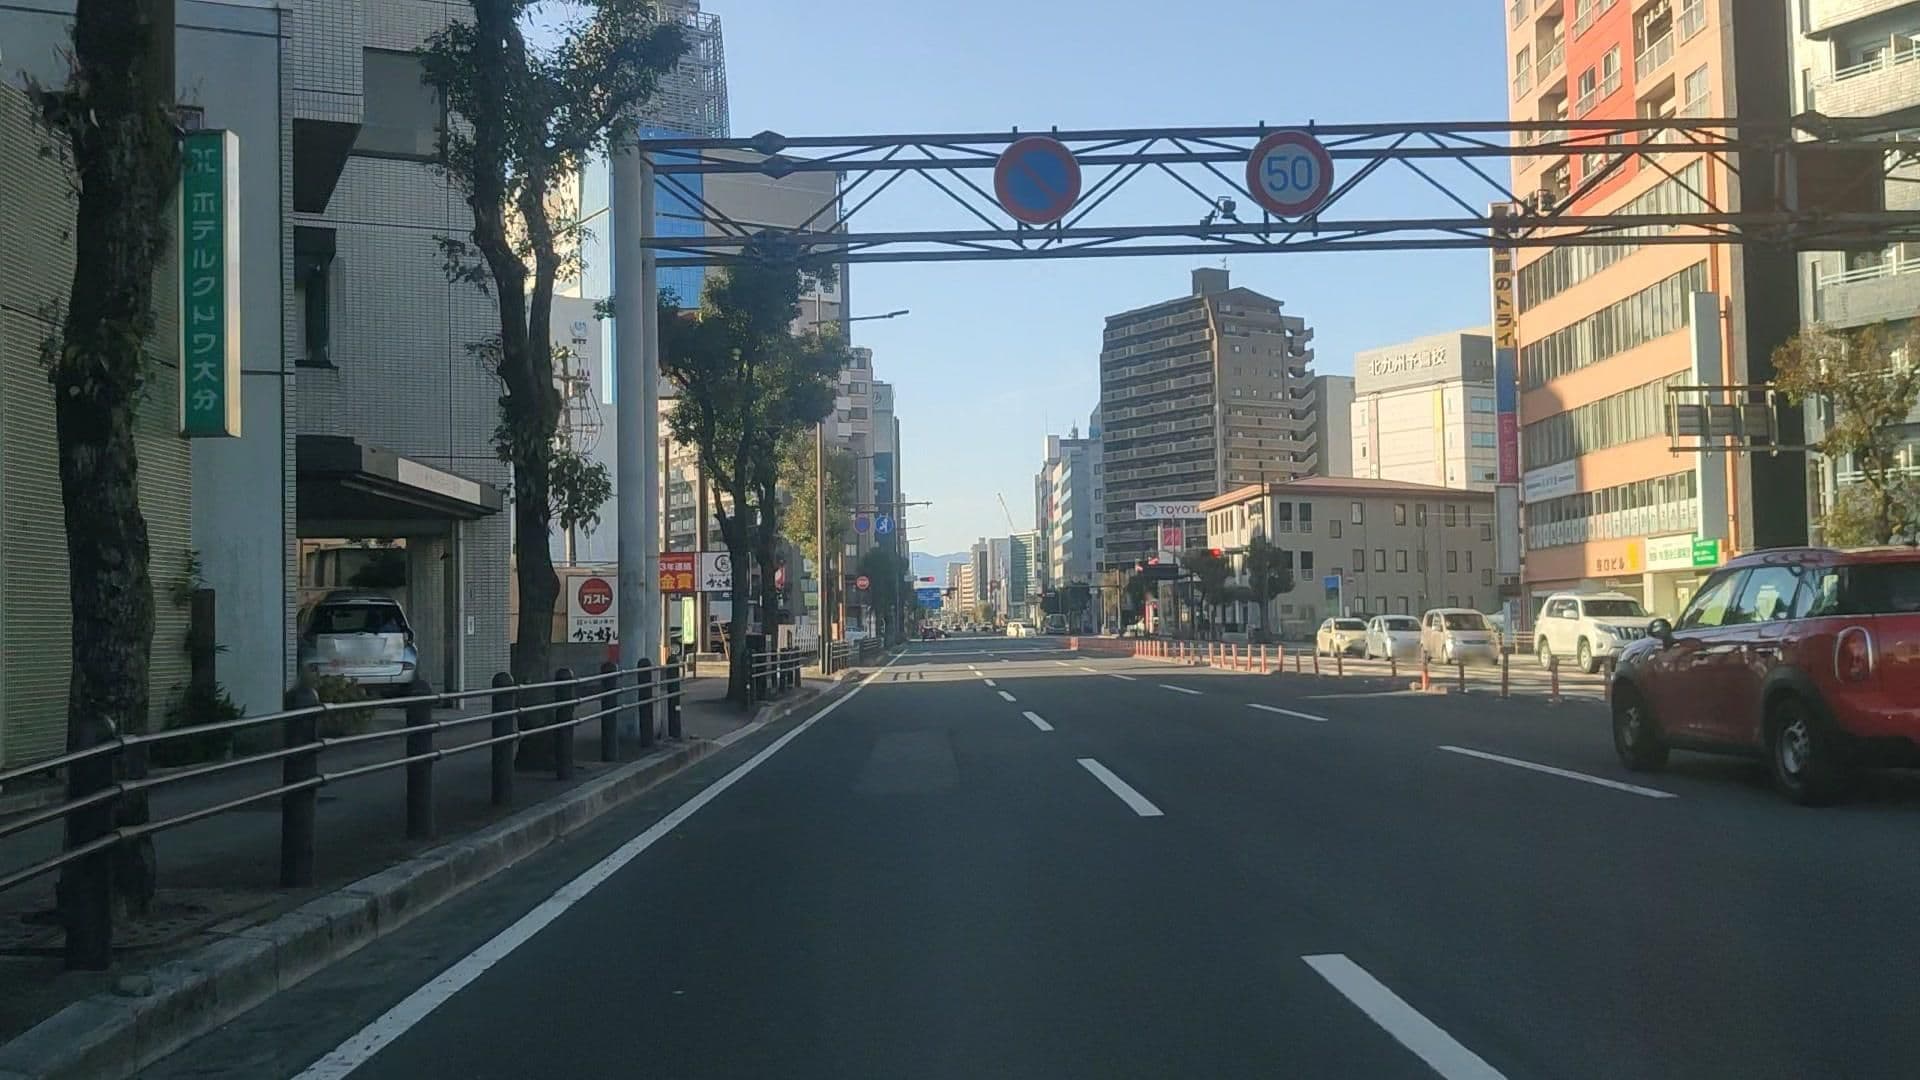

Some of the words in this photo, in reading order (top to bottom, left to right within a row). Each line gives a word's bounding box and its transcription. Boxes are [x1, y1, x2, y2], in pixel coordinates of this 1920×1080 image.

[1267, 156, 1313, 191] 50
[191, 191, 219, 411] ホテルクドウ大分
[1159, 505, 1200, 515] TOYOT
[583, 594, 610, 605] ガスト
[573, 627, 618, 642] から好し
